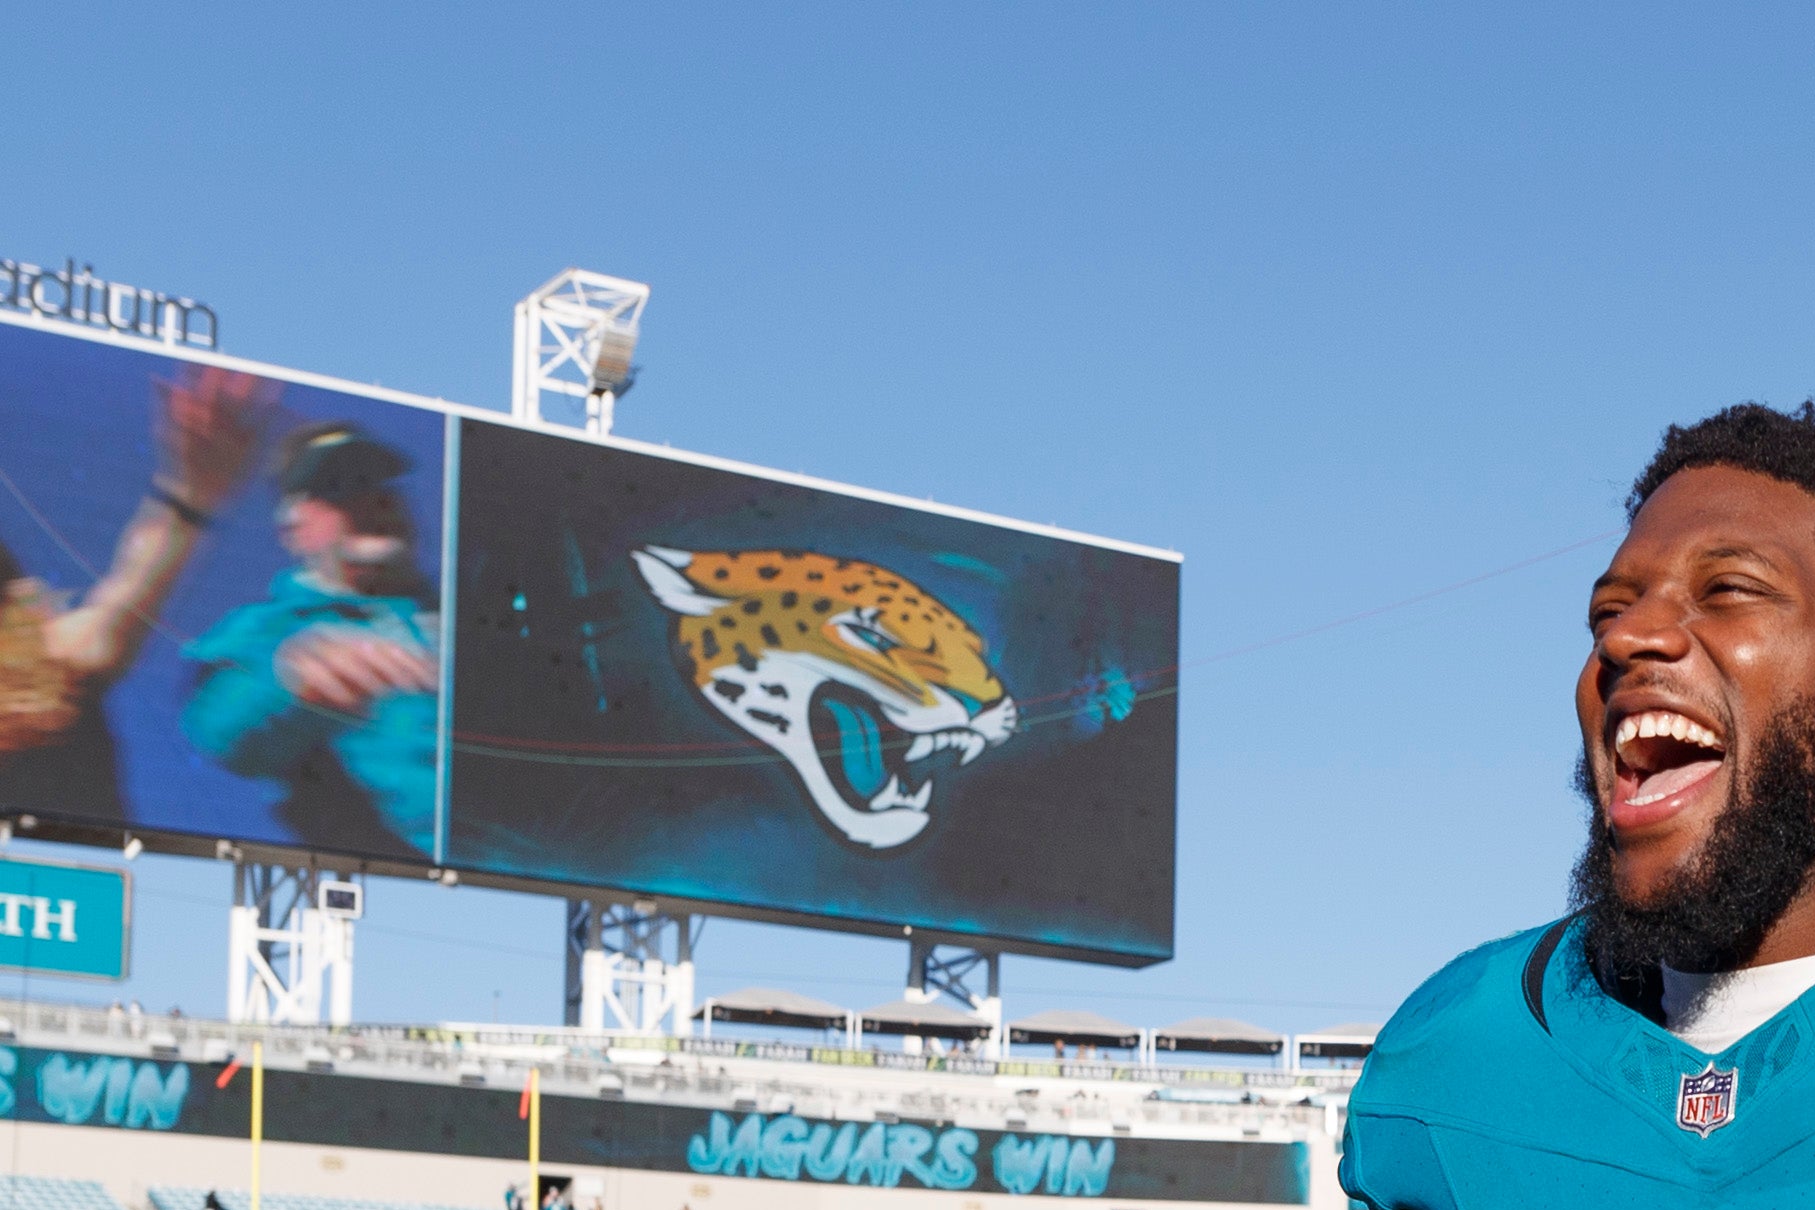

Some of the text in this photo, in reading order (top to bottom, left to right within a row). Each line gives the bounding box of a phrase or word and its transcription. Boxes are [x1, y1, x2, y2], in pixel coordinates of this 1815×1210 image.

[36, 1051, 191, 1130] WIN
[1685, 1094, 1725, 1123] NFL
[687, 1110, 1116, 1197] JAGUARS WIN
